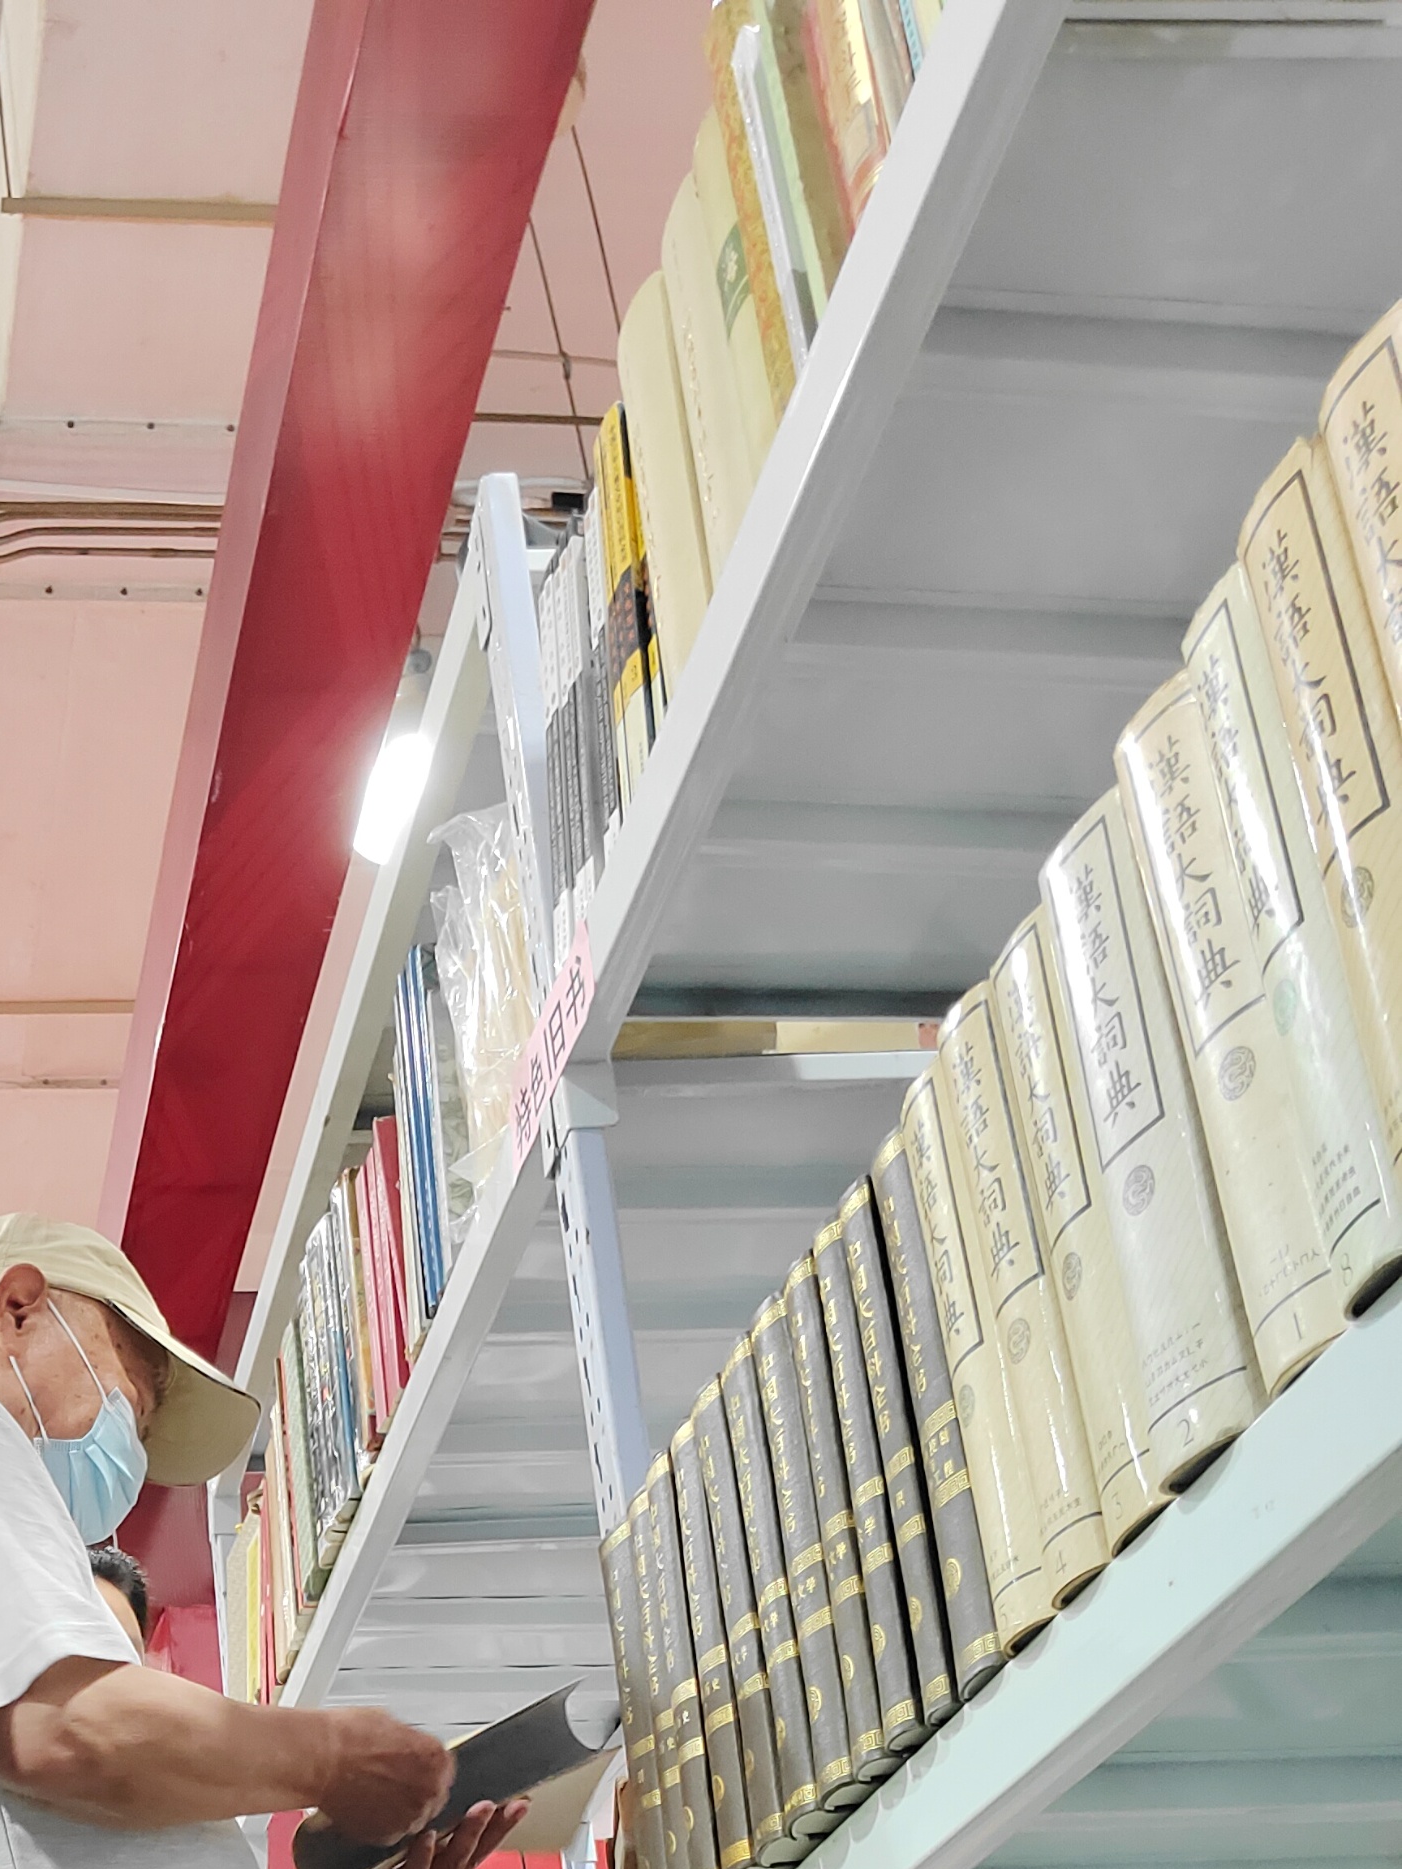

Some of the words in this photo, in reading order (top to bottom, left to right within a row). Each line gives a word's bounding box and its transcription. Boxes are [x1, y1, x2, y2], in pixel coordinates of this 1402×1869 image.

[1261, 528, 1358, 830] 漢語大詞典
[1148, 734, 1241, 1009] 漢語大詞典
[1070, 863, 1142, 1129] 漢語大詞典
[514, 955, 586, 1159] 特色旧书
[950, 1040, 1021, 1285] 漢語大詞典
[1340, 1252, 1354, 1287] 8
[1292, 1311, 1303, 1342] 1
[1177, 1417, 1195, 1448] 2
[1110, 1492, 1125, 1522] 3
[1055, 1549, 1069, 1577] 4
[998, 1602, 1010, 1633] 5
